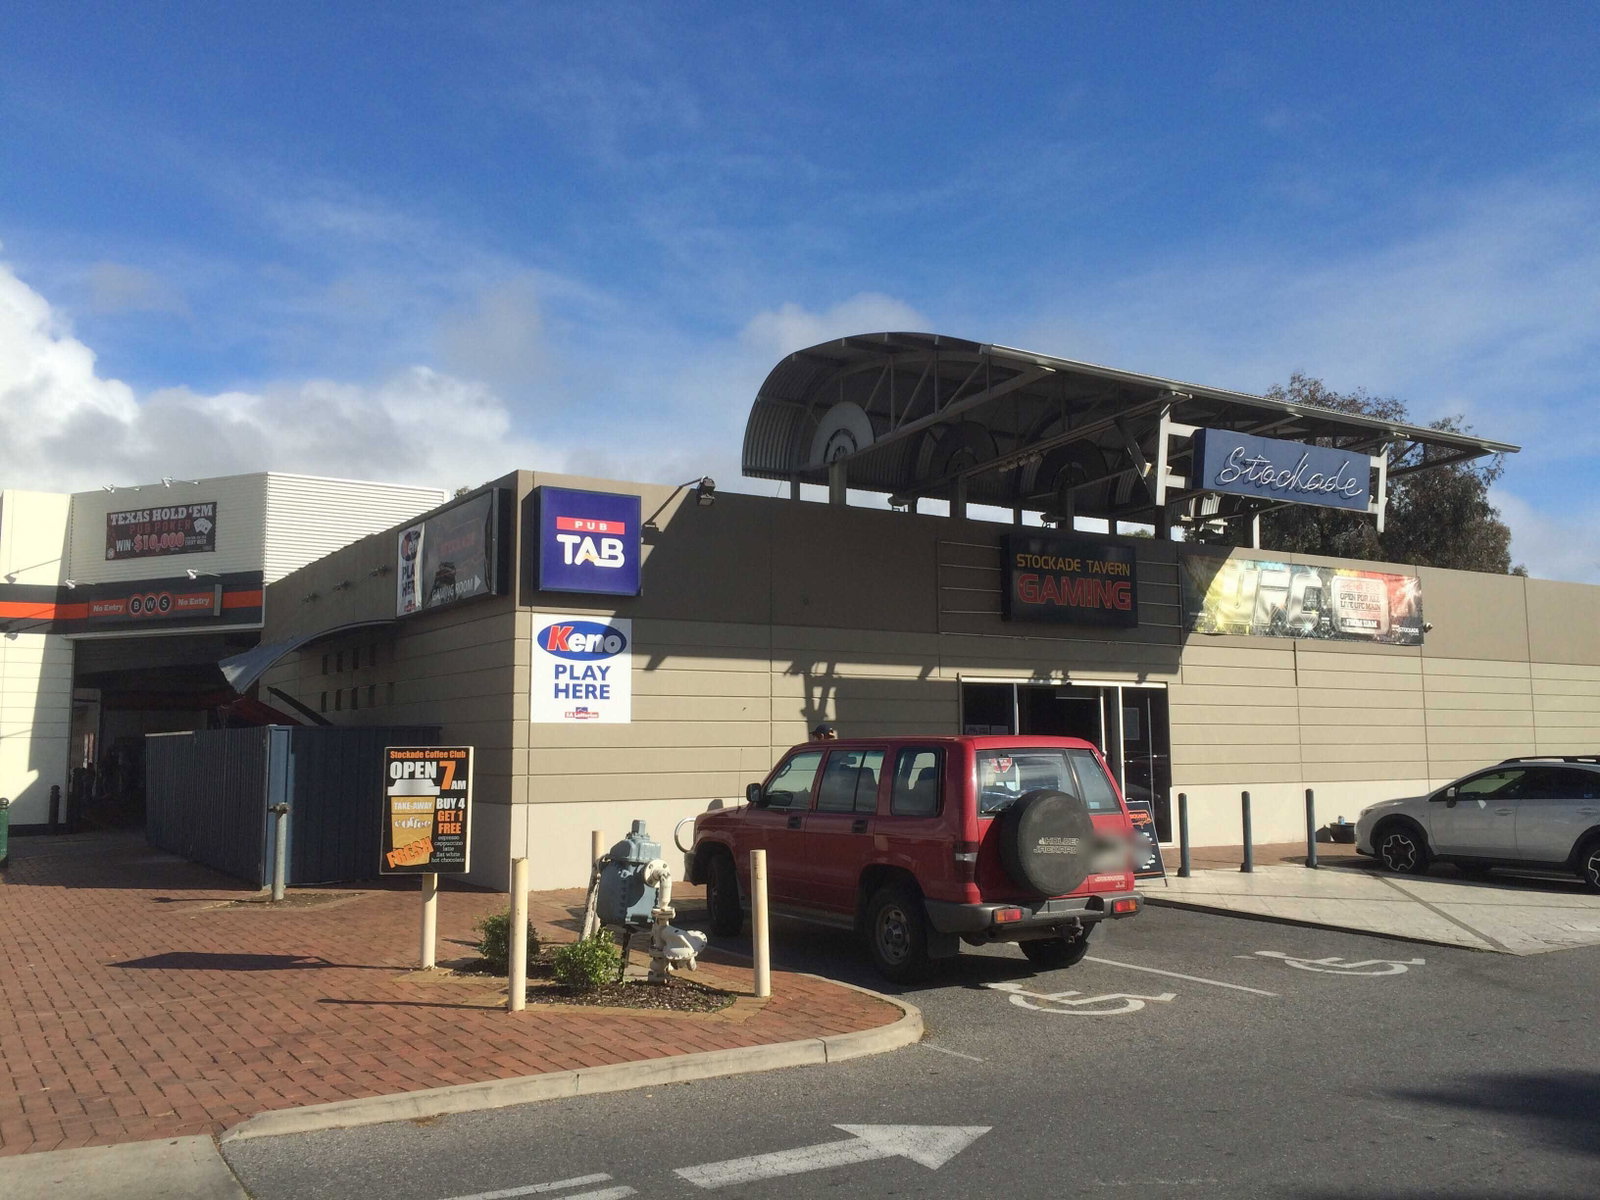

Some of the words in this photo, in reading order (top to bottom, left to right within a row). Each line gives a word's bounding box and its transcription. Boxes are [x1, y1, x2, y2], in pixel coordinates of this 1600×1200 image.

[1219, 446, 1363, 497] Stockade
[110, 511, 150, 526] TEXAS
[152, 507, 187, 522] HOLD
[574, 520, 608, 531] PUB
[116, 539, 131, 552] WIN
[133, 531, 185, 553] $10,000
[556, 533, 625, 568] TAB
[1016, 553, 1081, 572] STOCKADE
[1086, 559, 1131, 577] TAVERN
[1017, 573, 1132, 611] GAMING
[1218, 568, 1322, 628] UFC
[93, 604, 103, 612] No
[104, 604, 123, 612] Entry
[178, 598, 188, 606] No
[189, 598, 209, 606] Entry
[546, 625, 623, 653] Keno
[554, 664, 611, 681] PLAY
[554, 683, 611, 700] HERE
[390, 751, 424, 759] Stockade
[425, 751, 449, 759] Coffee
[389, 761, 437, 779] OPEN
[394, 801, 433, 810] TAKE-AWAY
[436, 798, 456, 809] BUY
[458, 797, 465, 809] 4
[437, 810, 456, 821] GET
[458, 810, 463, 821] 1
[438, 823, 461, 834] FREE
[386, 836, 434, 868] FRESH
